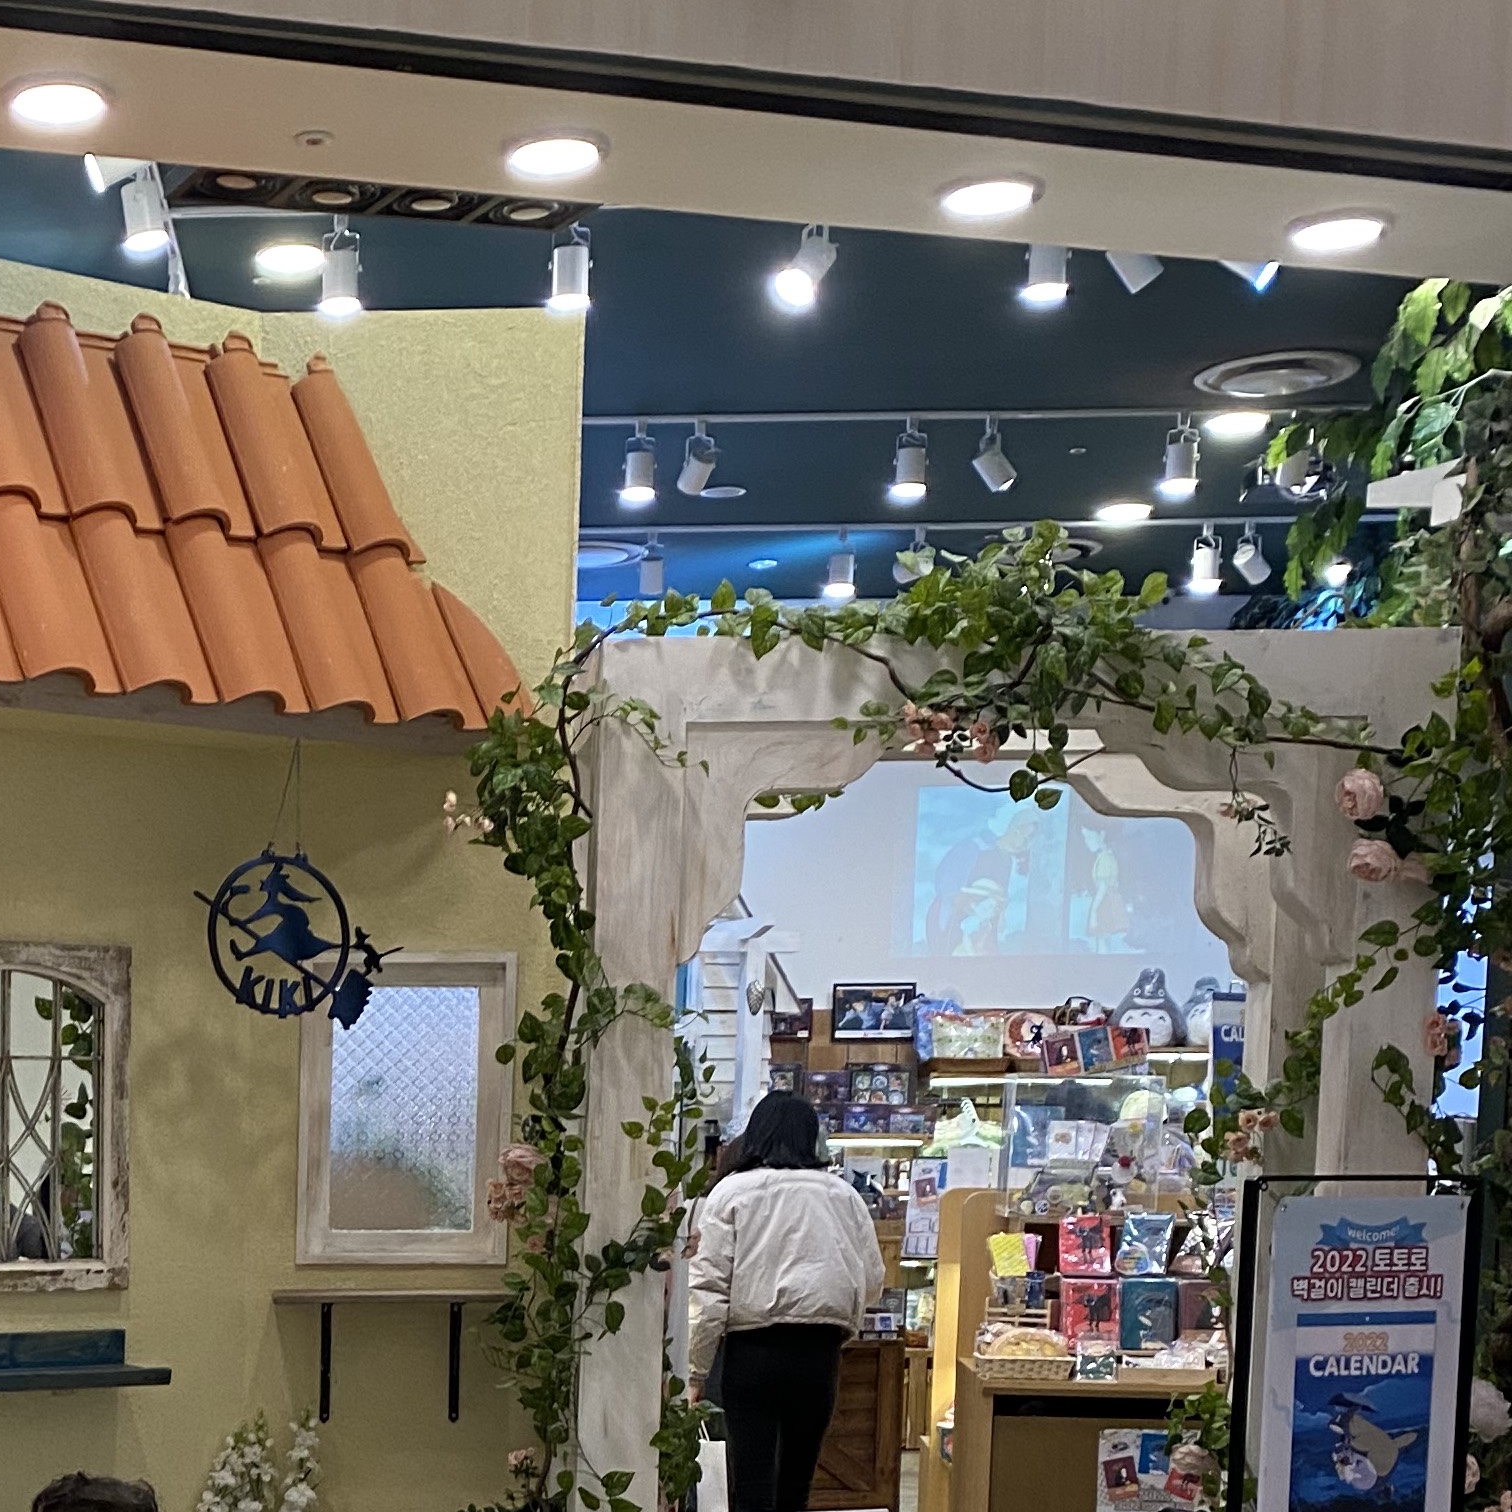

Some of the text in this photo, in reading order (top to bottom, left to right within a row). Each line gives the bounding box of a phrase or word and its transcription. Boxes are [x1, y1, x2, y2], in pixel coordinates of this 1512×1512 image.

[236, 966, 316, 1019] KIKI
[1221, 1024, 1245, 1043] CAL
[1312, 1248, 1427, 1273] 2022 토토로
[1293, 1276, 1442, 1300] 벽걸이 캘린더 출시!
[1343, 1332, 1389, 1352] 2022
[1309, 1352, 1420, 1378] CALENDAR
